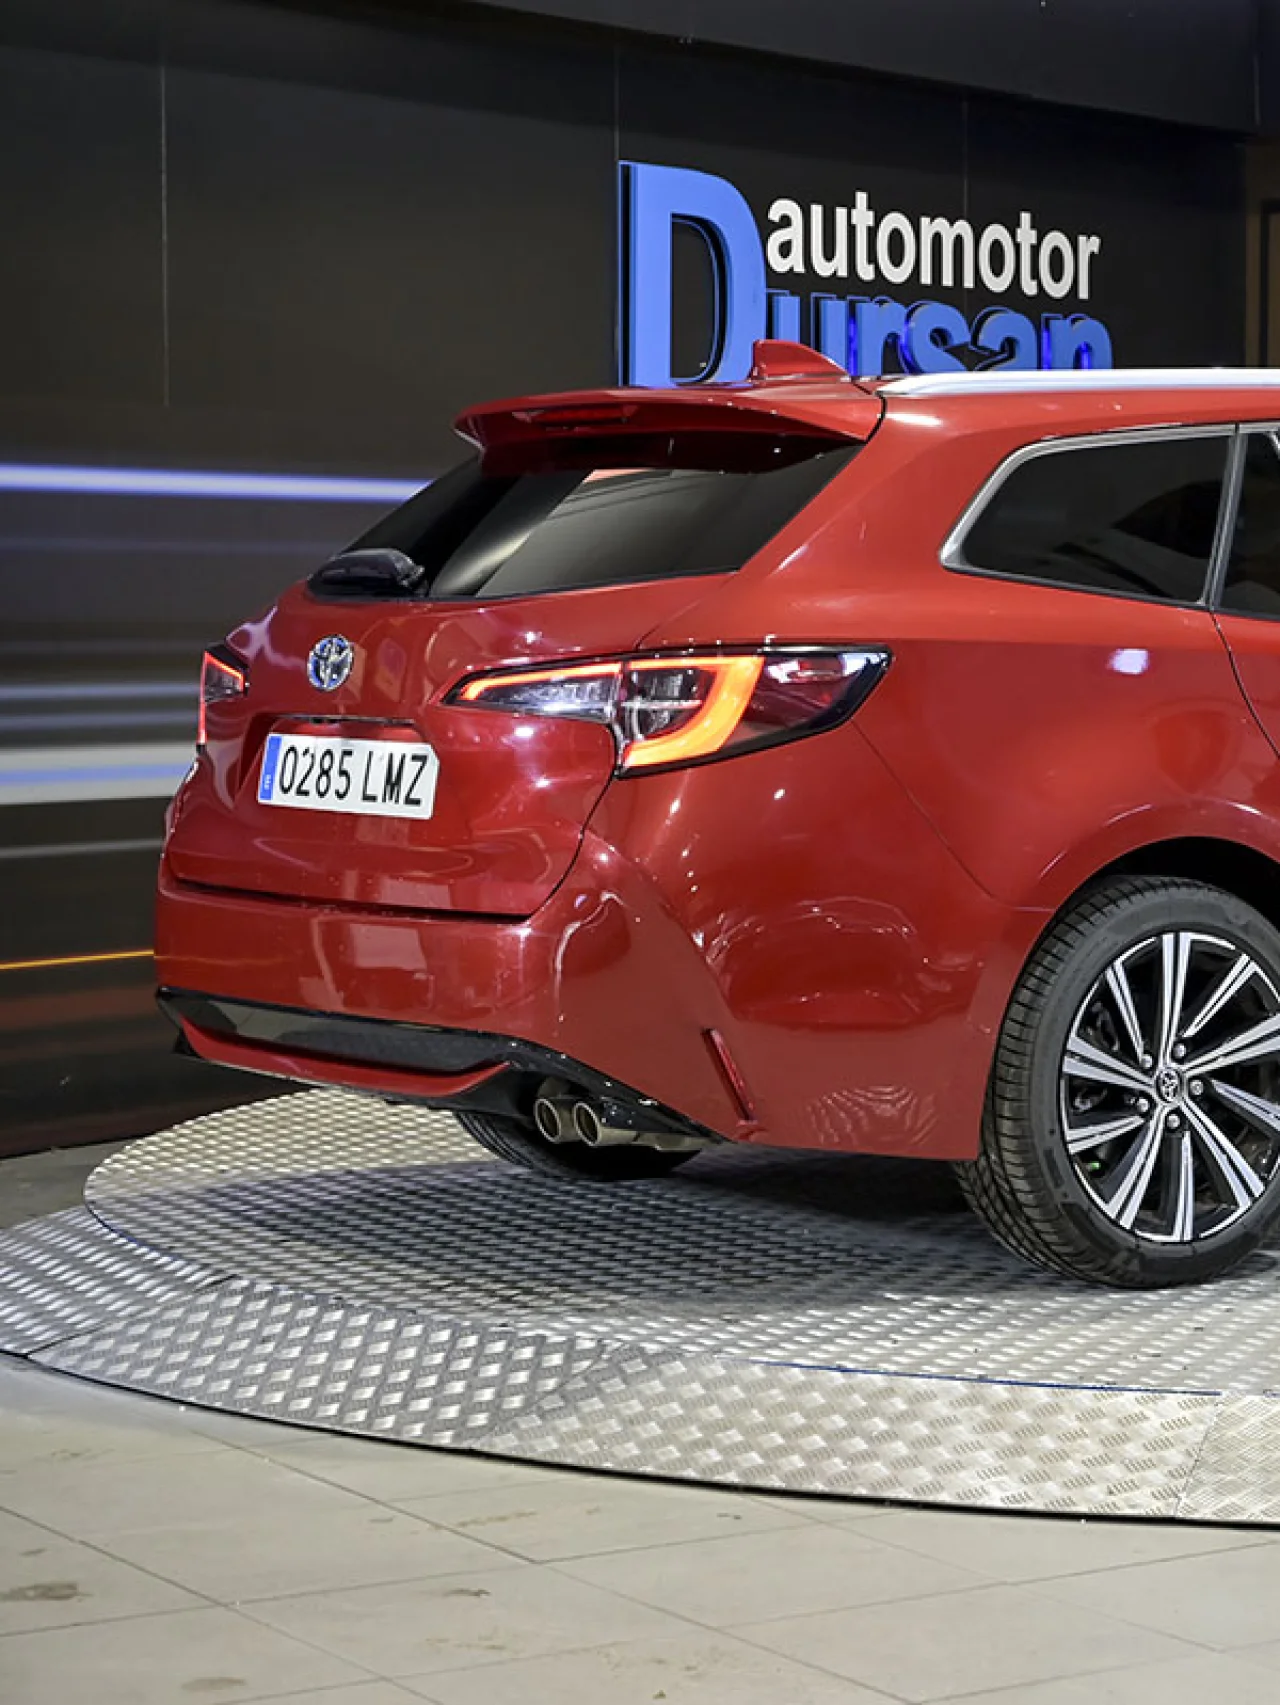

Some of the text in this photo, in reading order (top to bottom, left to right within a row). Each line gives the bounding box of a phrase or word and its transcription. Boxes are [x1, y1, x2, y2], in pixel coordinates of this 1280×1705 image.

[766, 190, 1101, 300] automotor
[279, 744, 429, 806] 0285 LMZ
